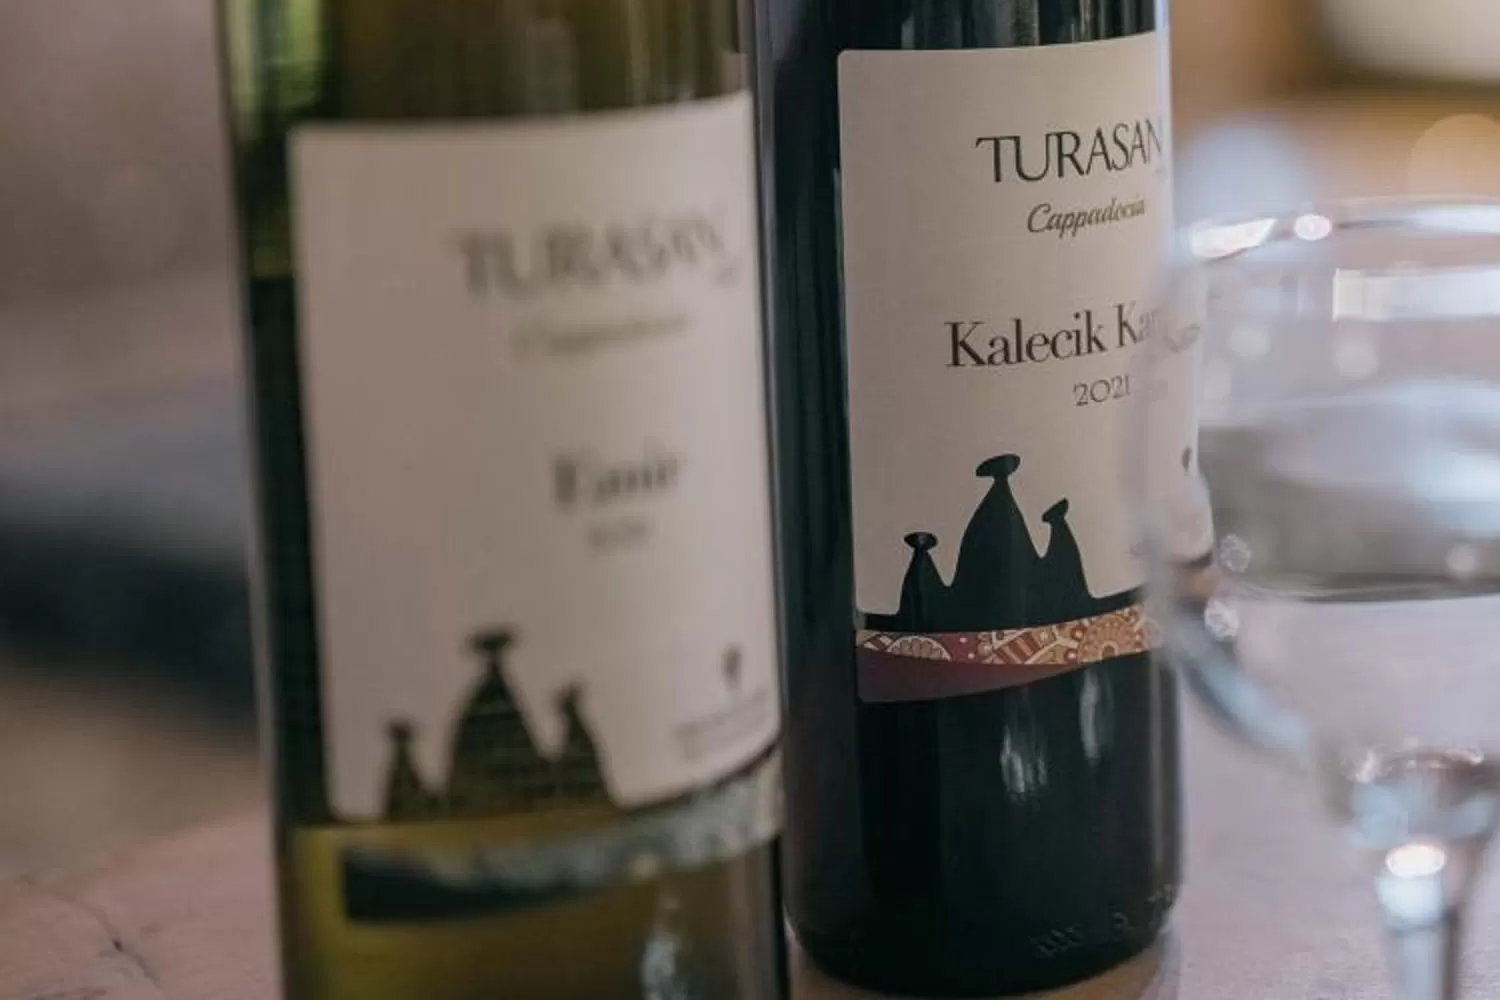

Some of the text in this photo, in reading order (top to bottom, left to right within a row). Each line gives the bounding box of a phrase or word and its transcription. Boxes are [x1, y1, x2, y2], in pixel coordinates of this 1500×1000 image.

[975, 117, 1163, 183] TURASAN
[944, 309, 1108, 368] Kalecik
[1073, 373, 1131, 406] 2021
